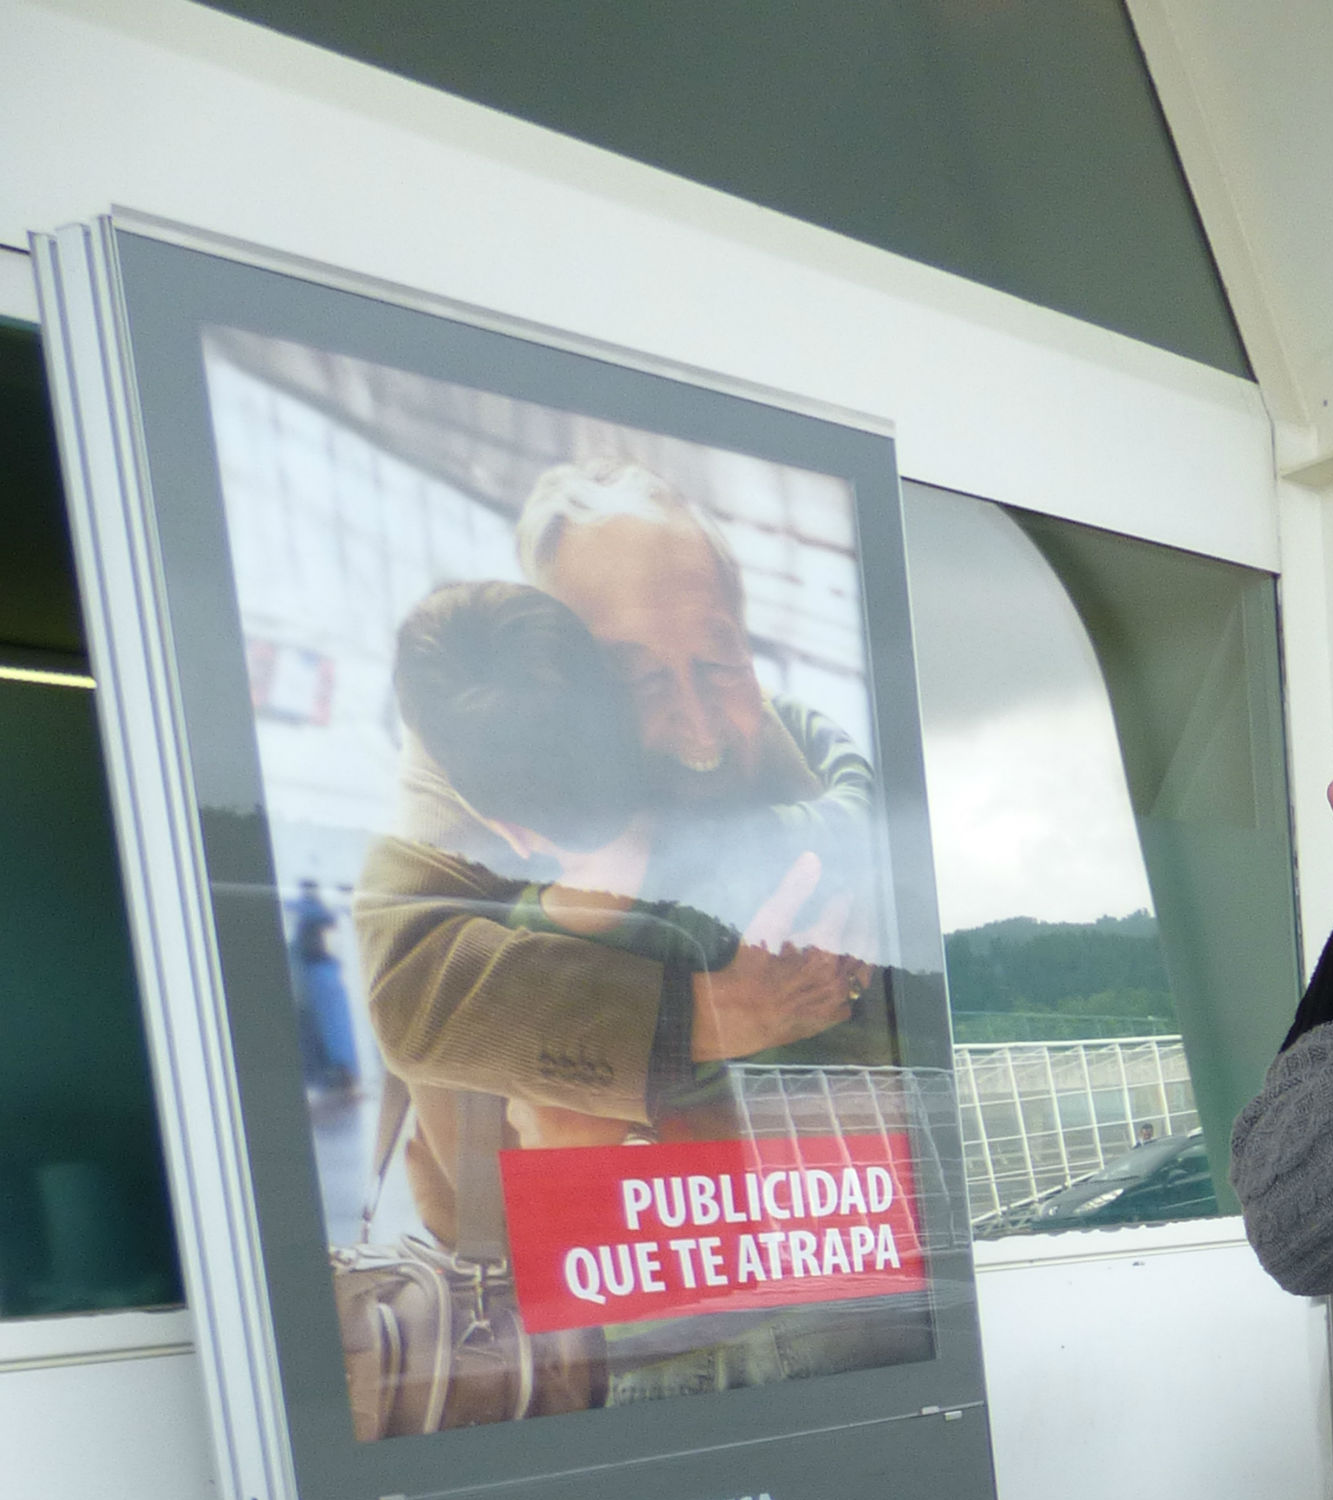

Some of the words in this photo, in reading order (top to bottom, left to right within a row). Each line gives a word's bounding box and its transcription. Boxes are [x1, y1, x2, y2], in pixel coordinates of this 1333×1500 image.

[622, 1166, 894, 1231] PUBLICIDAD
[564, 1242, 666, 1305] QUE
[669, 1237, 729, 1289] TE
[738, 1223, 901, 1283] ATRAPA
